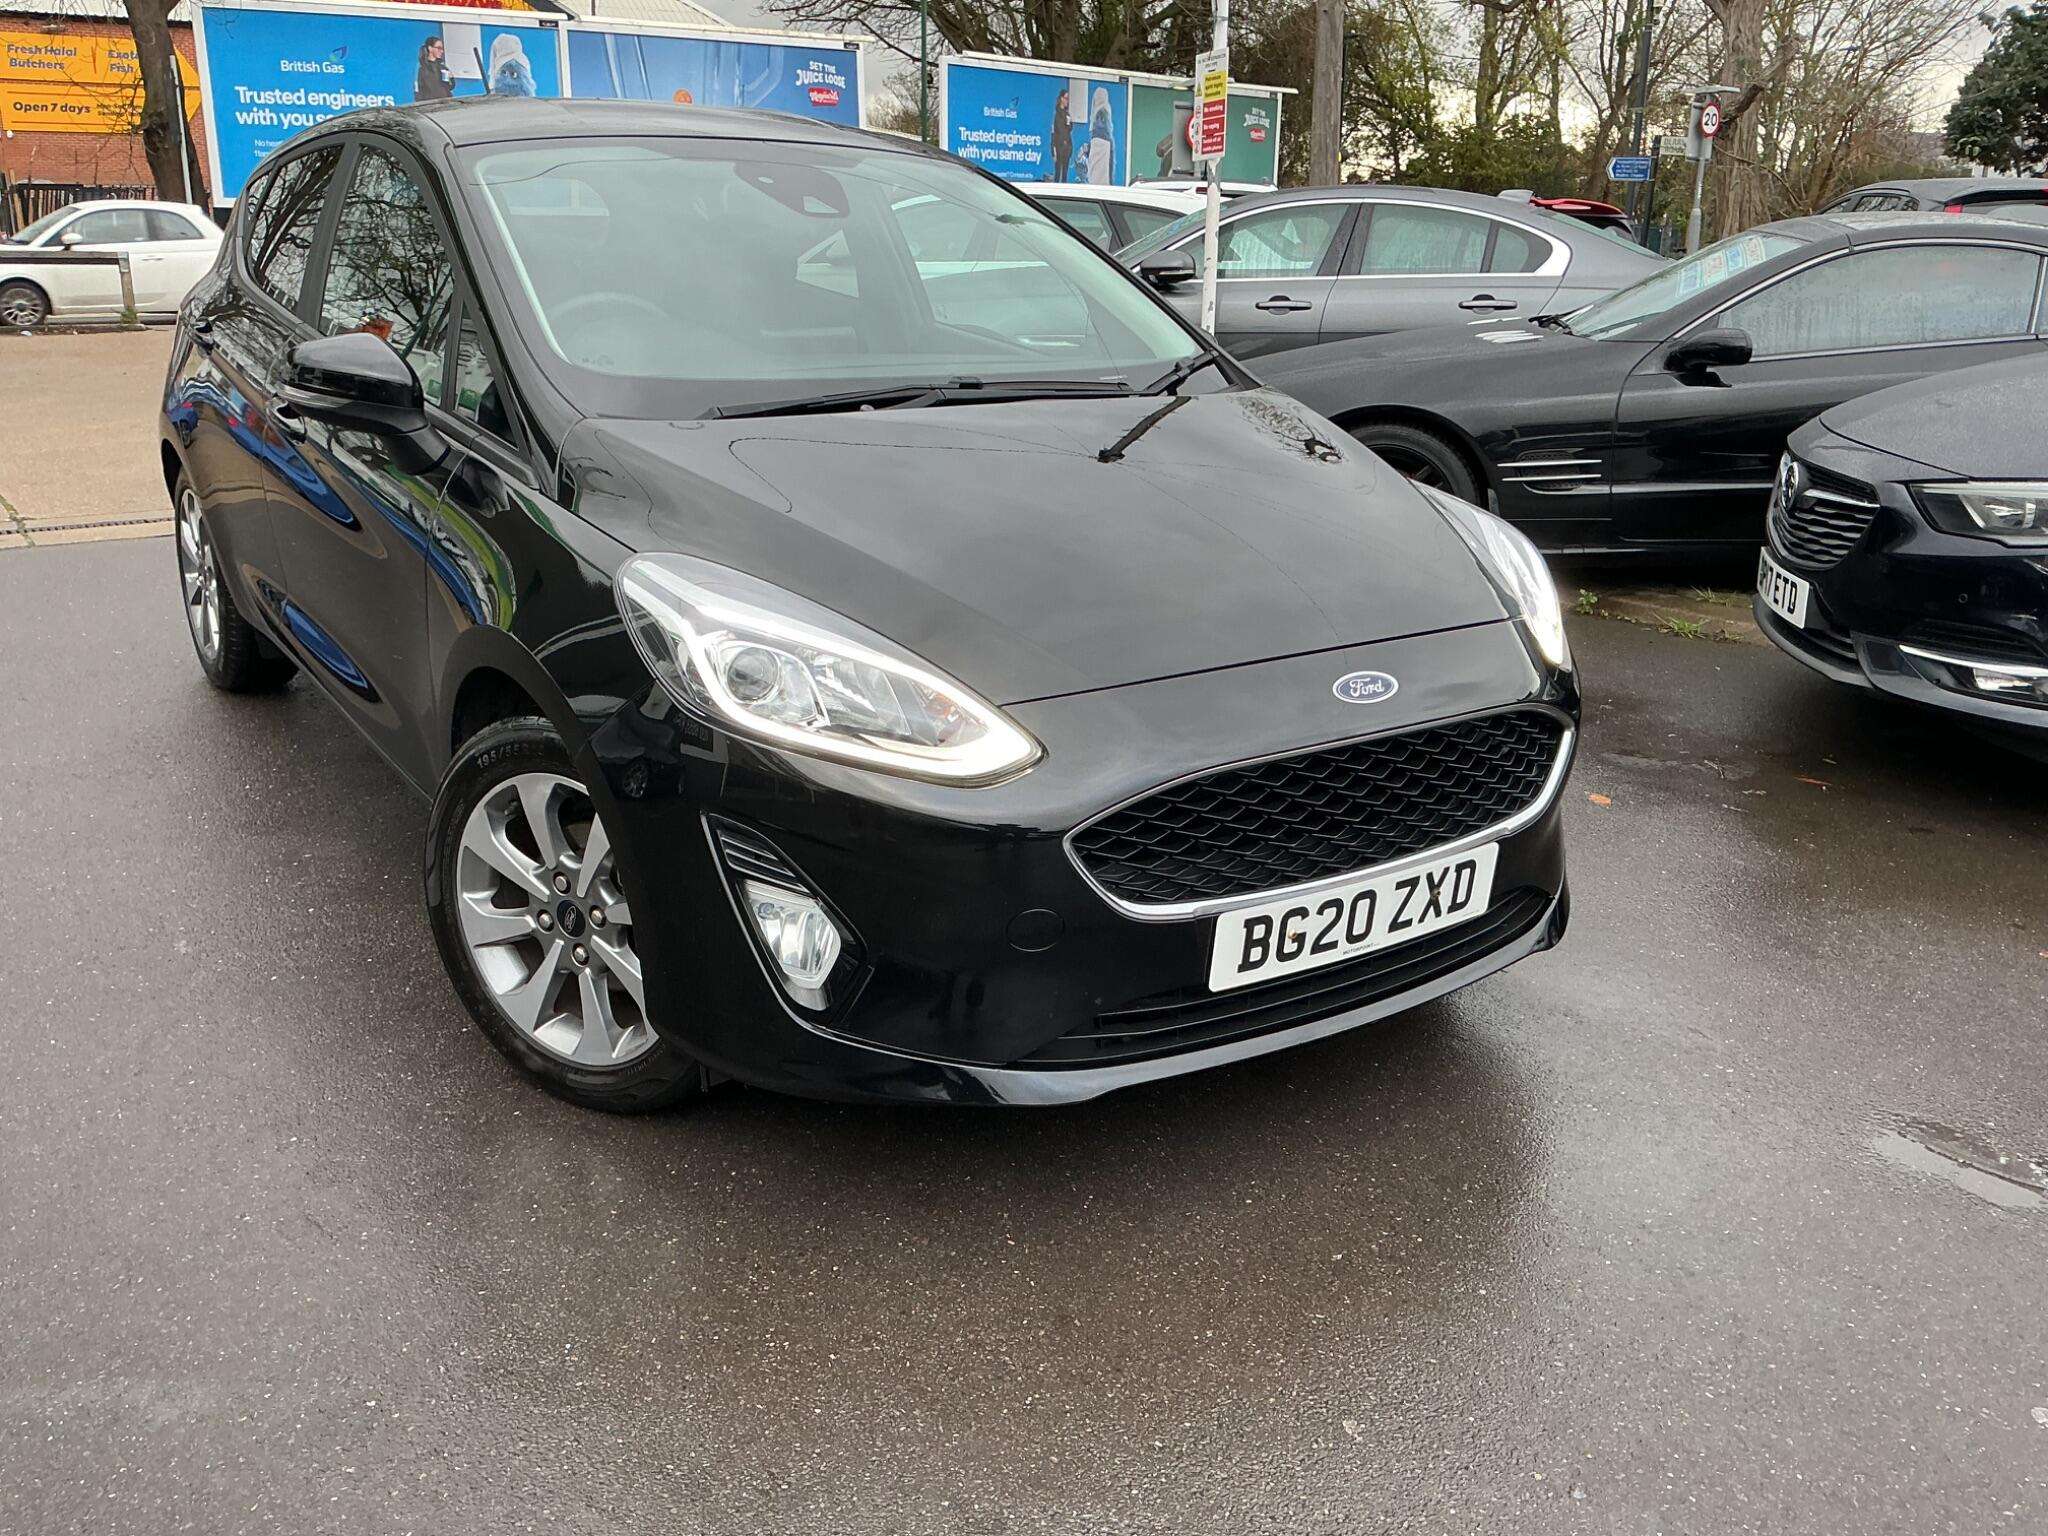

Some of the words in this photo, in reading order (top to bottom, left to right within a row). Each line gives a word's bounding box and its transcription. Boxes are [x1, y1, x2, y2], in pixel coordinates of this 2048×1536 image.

[7, 43, 42, 55] Fresh
[44, 45, 77, 57] Halal
[9, 57, 65, 70] Butchers
[109, 63, 134, 73] Fish
[280, 60, 320, 73] British
[322, 62, 345, 74] Gas
[809, 61, 823, 72] SET
[824, 64, 836, 73] THE
[795, 69, 824, 86] JUICE
[824, 73, 846, 89] LOOSE
[234, 86, 305, 105] Trusted
[308, 89, 395, 110] engineers
[13, 101, 48, 113] Open
[50, 103, 58, 112] 7
[60, 103, 90, 114] days
[983, 106, 1004, 117] British
[1005, 108, 1018, 119] Gas
[235, 107, 277, 126] with
[280, 112, 314, 130] you
[1704, 112, 1718, 126] 20
[958, 127, 995, 143] Trusted
[996, 130, 1041, 147] engineers
[958, 144, 979, 159] with
[981, 149, 998, 162] you
[999, 150, 1024, 161] same
[1025, 148, 1042, 165] day
[1774, 571, 1798, 615] ETD
[1349, 677, 1385, 698] Ford
[1237, 888, 1377, 974] BG20
[1387, 858, 1477, 934] ZXD
